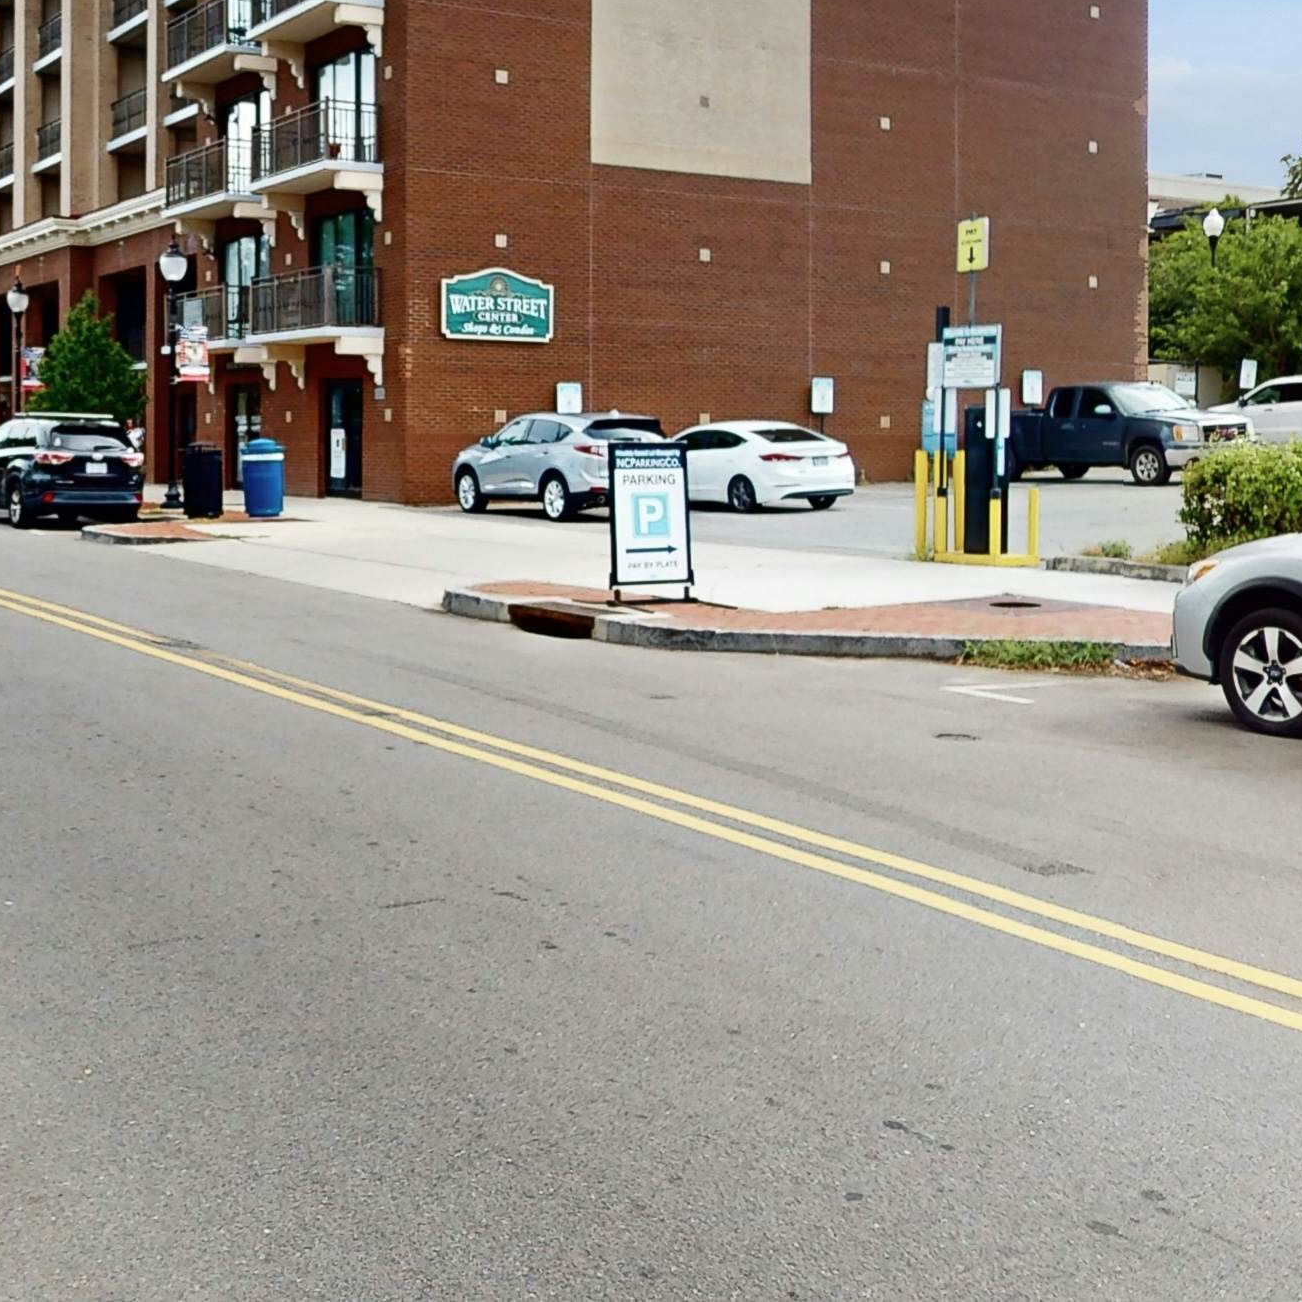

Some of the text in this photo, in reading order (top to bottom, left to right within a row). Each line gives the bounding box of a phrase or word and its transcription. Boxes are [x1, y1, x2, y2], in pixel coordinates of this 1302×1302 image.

[449, 294, 547, 319] WATER STREET
[477, 311, 518, 322] CENTER
[461, 321, 488, 335] Shops
[503, 324, 534, 335] Condos
[623, 474, 676, 485] PARKING
[638, 498, 664, 534] P
[627, 560, 679, 569] PAY BY PLATE
